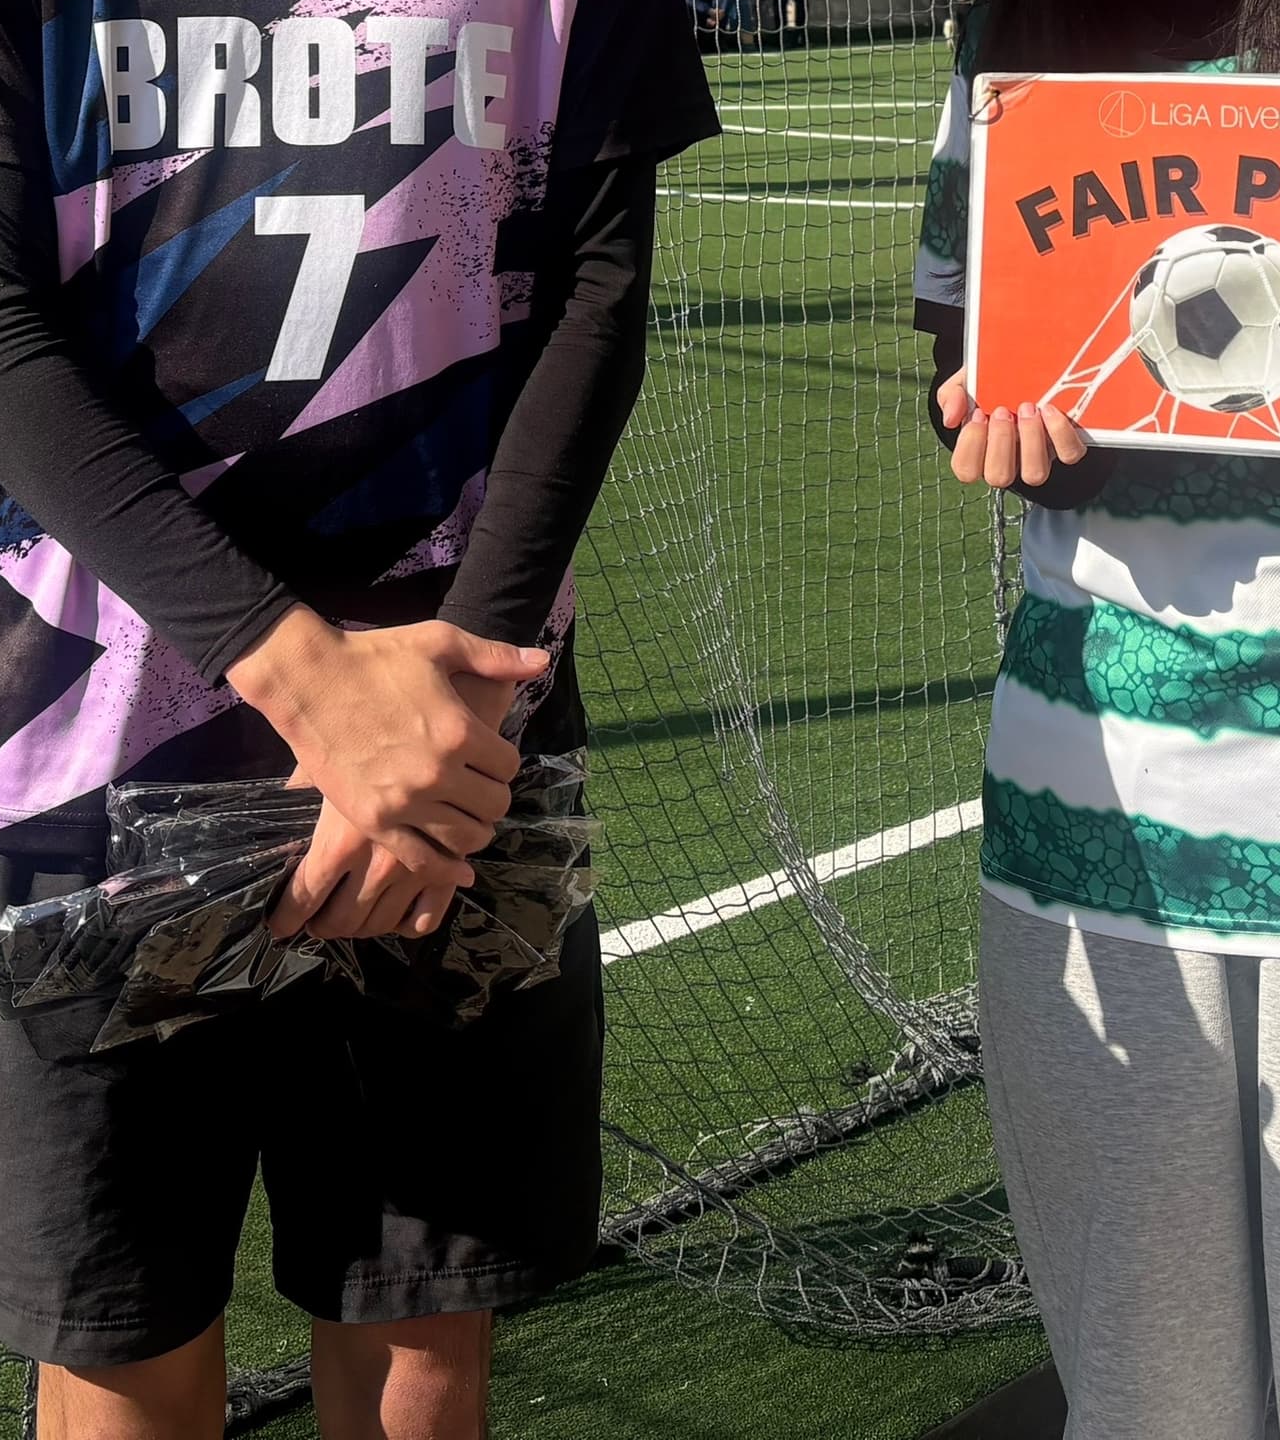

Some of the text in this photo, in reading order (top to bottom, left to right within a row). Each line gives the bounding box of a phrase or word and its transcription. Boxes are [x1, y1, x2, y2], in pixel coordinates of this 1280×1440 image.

[93, 16, 515, 155] BROTE
[1016, 155, 1206, 256] FAIR
[255, 195, 366, 382] 7
